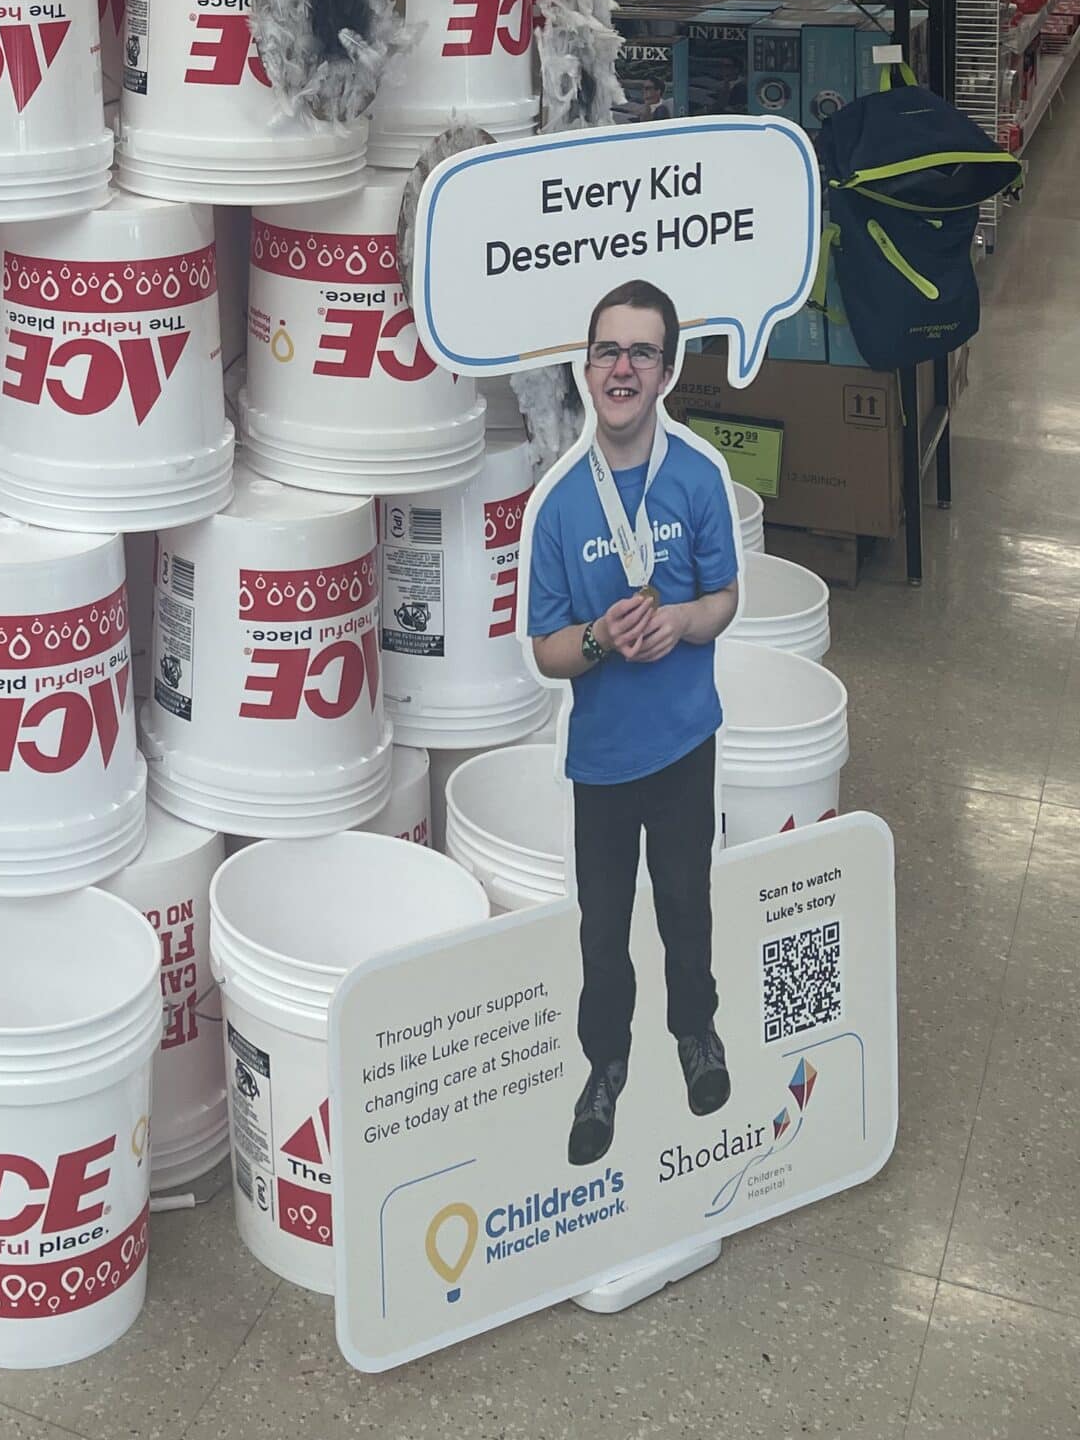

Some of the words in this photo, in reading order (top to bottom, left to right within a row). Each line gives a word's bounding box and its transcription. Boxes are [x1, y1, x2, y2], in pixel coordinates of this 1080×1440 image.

[30, 4, 66, 18] The
[688, 26, 747, 41] INTEX
[616, 46, 669, 61] NTEX
[541, 176, 642, 214] Every
[649, 162, 702, 200] Kid
[486, 229, 647, 276] Deserves
[657, 208, 754, 252] HOPE
[320, 290, 385, 306] place.
[6, 310, 54, 331] place.
[63, 319, 141, 336] helpful
[150, 316, 185, 331] The
[3, 330, 190, 424] ACE
[583, 520, 682, 562] Chaion
[247, 627, 312, 644] place.
[36, 662, 104, 692] helpful
[759, 885, 788, 901] Scan
[792, 881, 803, 892] to
[807, 868, 841, 887] watch
[167, 899, 193, 926] NO
[767, 902, 803, 923] Luke's
[807, 894, 835, 907] story
[376, 1016, 442, 1049] Through
[447, 1004, 481, 1030] your
[487, 982, 549, 1013] support,
[362, 1062, 395, 1084] kids
[400, 1052, 427, 1072] like
[432, 1038, 469, 1060] Luke
[474, 1016, 530, 1047] receive
[535, 1009, 562, 1027] life-
[365, 1078, 439, 1113] changing
[444, 1064, 477, 1087] care
[482, 1057, 497, 1072] at
[501, 1037, 561, 1067] Shodair.
[364, 1118, 400, 1144] Give
[406, 1104, 450, 1131] today
[455, 1095, 469, 1111] at
[473, 1088, 497, 1106] the
[502, 1062, 564, 1097] register!
[659, 1123, 765, 1184] Shodair
[288, 1159, 331, 1184] The
[747, 1163, 793, 1187] Children's
[485, 1167, 624, 1238] Children's
[747, 1179, 785, 1200] Hospital
[40, 1227, 109, 1257] place.
[486, 1229, 550, 1264] Miracle
[556, 1198, 626, 1238] Network
